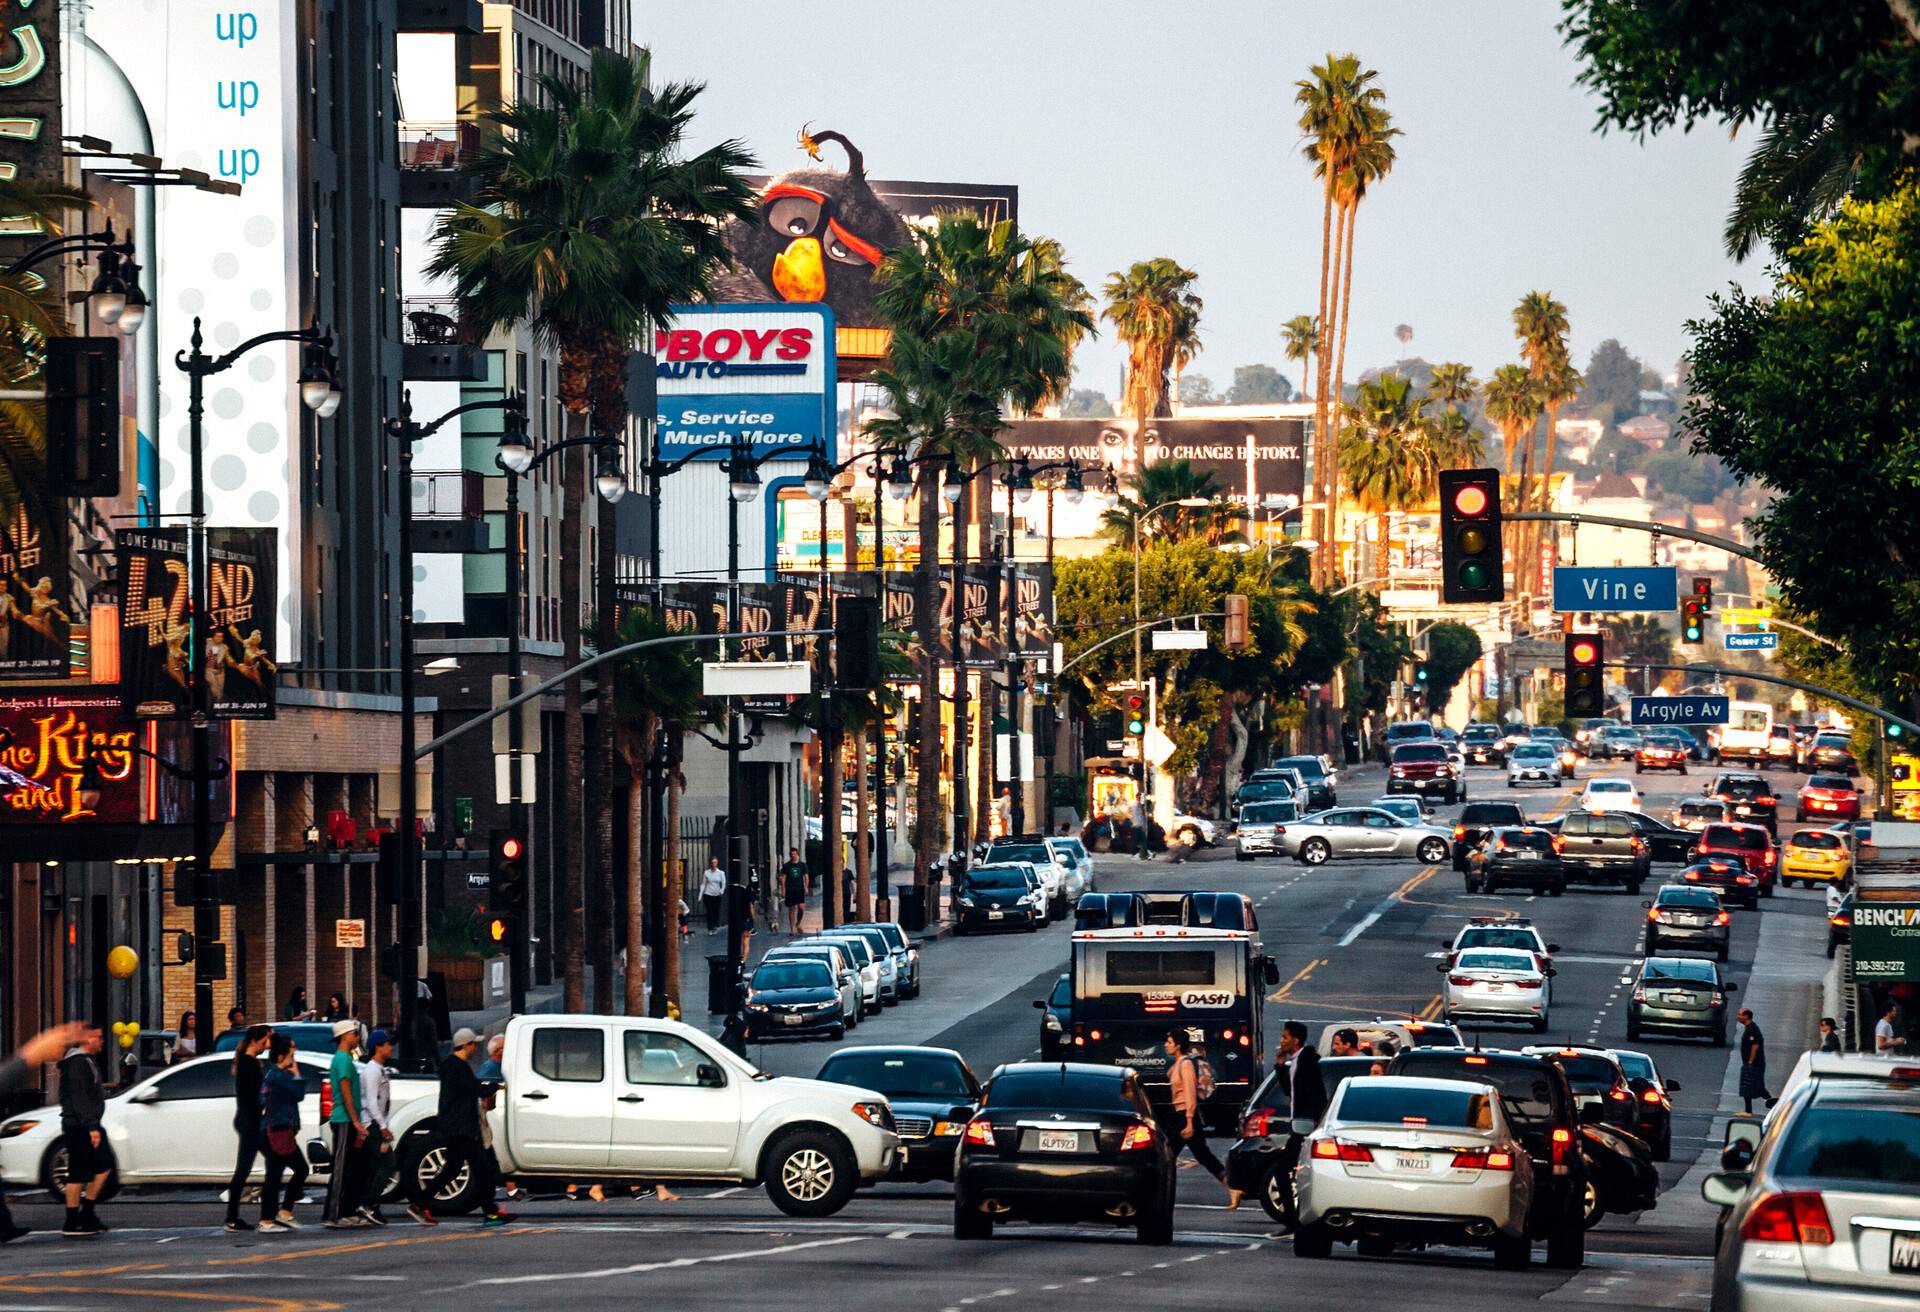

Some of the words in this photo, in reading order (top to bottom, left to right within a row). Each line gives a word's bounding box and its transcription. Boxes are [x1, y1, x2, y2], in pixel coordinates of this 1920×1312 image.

[216, 13, 257, 48] up
[217, 81, 259, 116] up
[219, 149, 260, 184] up
[657, 361, 728, 379] AUTO
[680, 410, 774, 425] Service
[664, 430, 732, 445] Much
[740, 430, 803, 444] More
[1020, 445, 1065, 460] TAKES
[1069, 446, 1100, 460] ONE
[1173, 446, 1234, 460] CHANGE
[1236, 446, 1300, 460] HSTORY.
[211, 562, 255, 610] ND
[963, 583, 988, 609] ND
[1017, 580, 1040, 603] ND
[1583, 578, 1647, 600] Vine
[209, 604, 254, 630] STREET
[1762, 636, 1774, 646] St
[1639, 703, 1694, 721] Argyle
[1701, 702, 1721, 717] Av
[31, 710, 136, 781] King
[11, 777, 65, 812] and
[61, 773, 97, 822] I
[1186, 994, 1231, 1005] DASH
